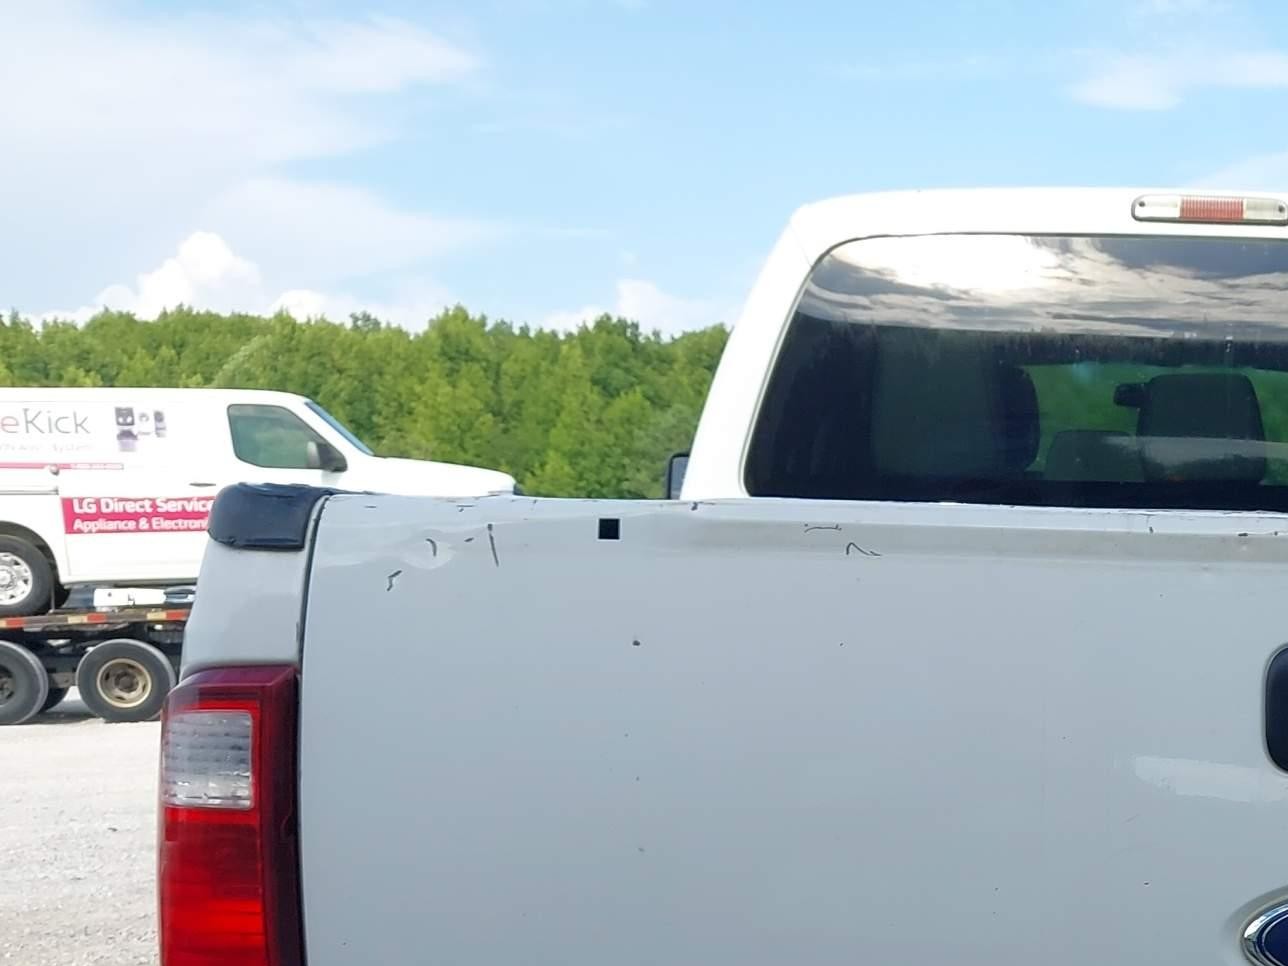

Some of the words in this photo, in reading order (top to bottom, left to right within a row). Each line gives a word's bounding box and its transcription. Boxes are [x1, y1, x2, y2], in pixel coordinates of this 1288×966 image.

[72, 497, 97, 514] LG
[100, 497, 153, 514] Direct
[73, 518, 136, 533] Appliance
[138, 517, 151, 530] &
